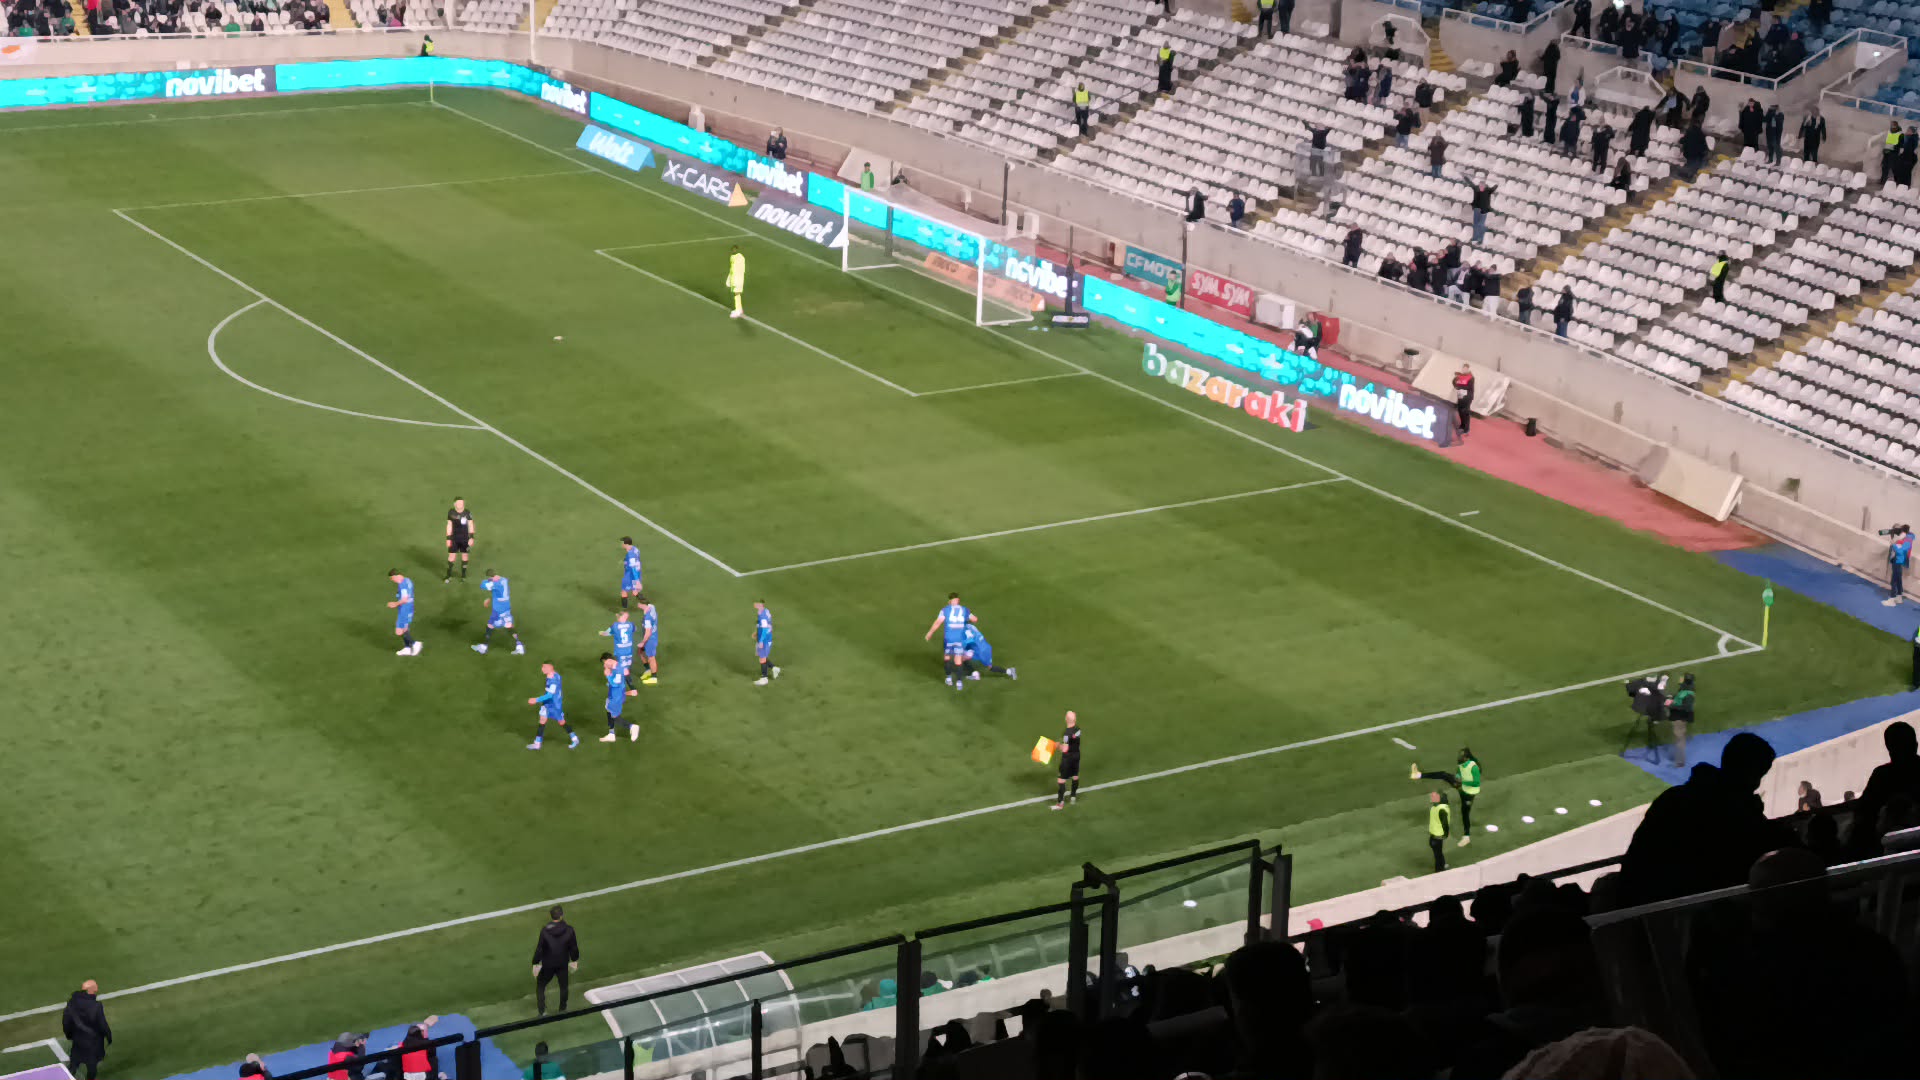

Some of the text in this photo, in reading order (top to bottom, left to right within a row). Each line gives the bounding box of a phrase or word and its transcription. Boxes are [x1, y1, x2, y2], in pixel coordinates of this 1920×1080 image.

[165, 68, 266, 97] novibet
[663, 159, 732, 201] X-CARS
[746, 158, 804, 197] novibet
[753, 203, 834, 244] novibet
[1192, 272, 1251, 308] SYM SYM
[1142, 343, 1307, 432] bazaraki
[1338, 383, 1438, 440] novibet
